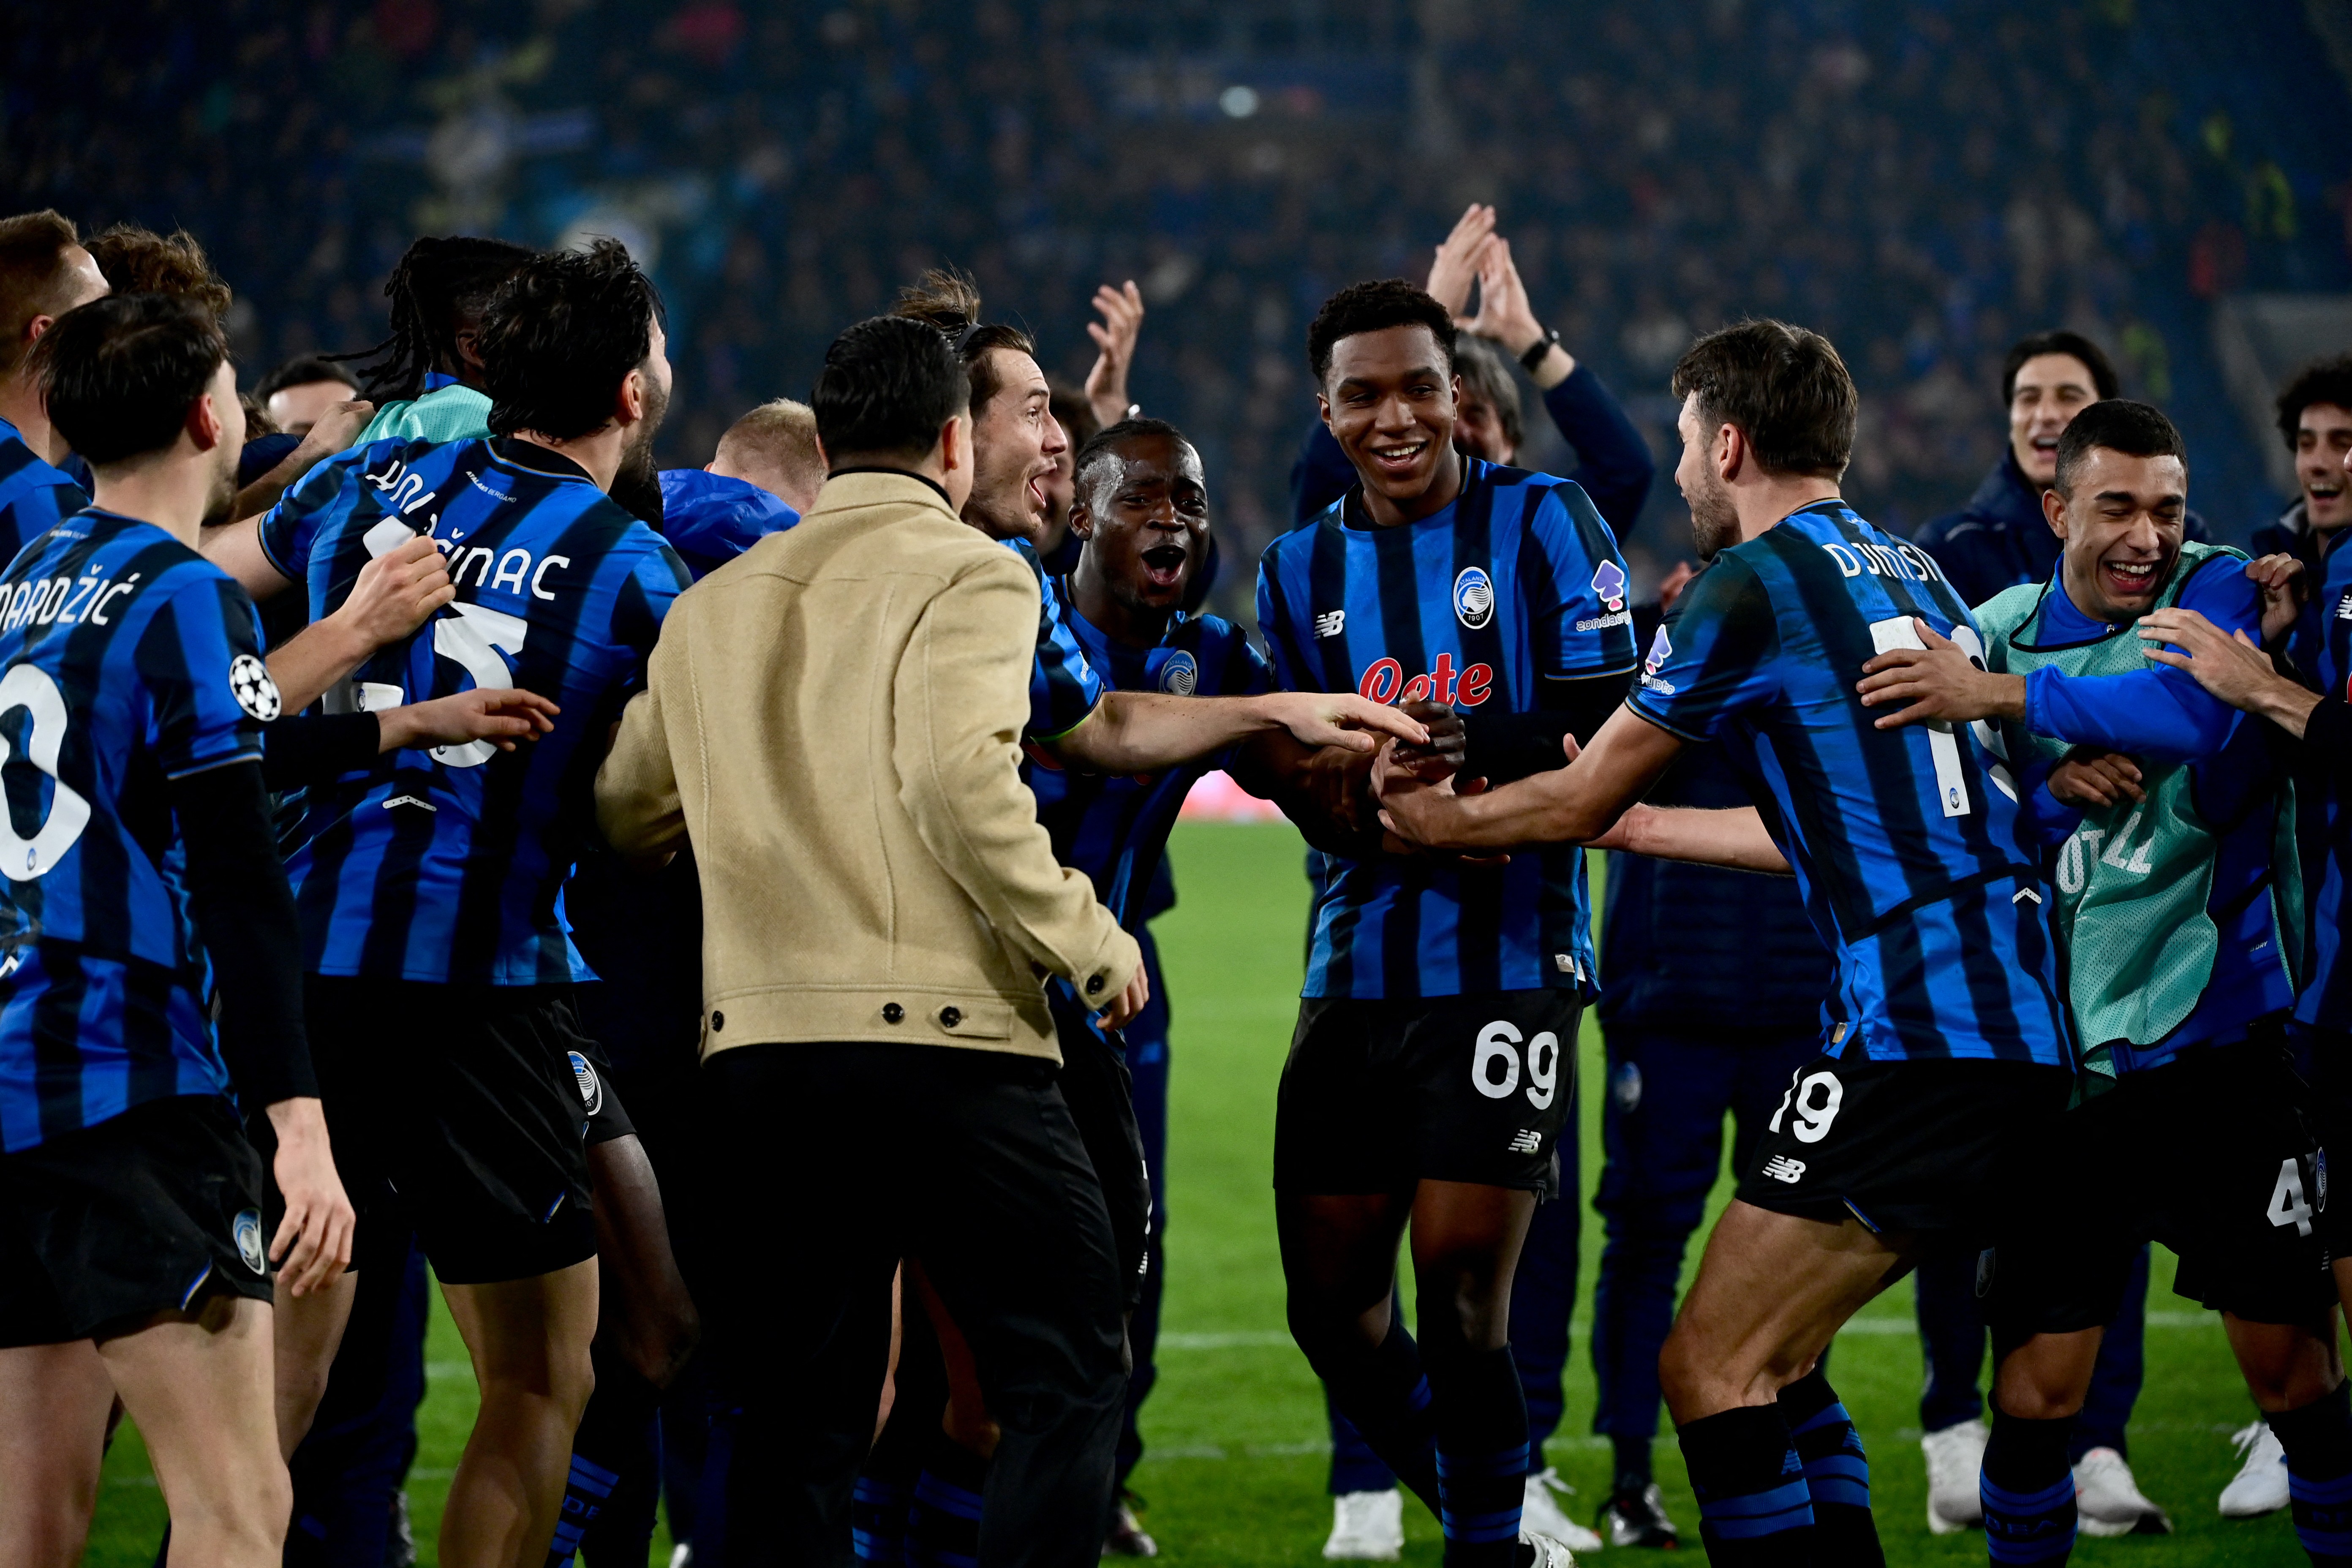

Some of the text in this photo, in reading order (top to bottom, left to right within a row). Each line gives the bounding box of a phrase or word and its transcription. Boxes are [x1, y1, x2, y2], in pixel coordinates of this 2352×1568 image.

[1459, 576, 1485, 586] ATALANTA
[1468, 613, 1484, 621] 1907
[1472, 1020, 1559, 1110] 69
[1769, 1066, 1843, 1143] 19
